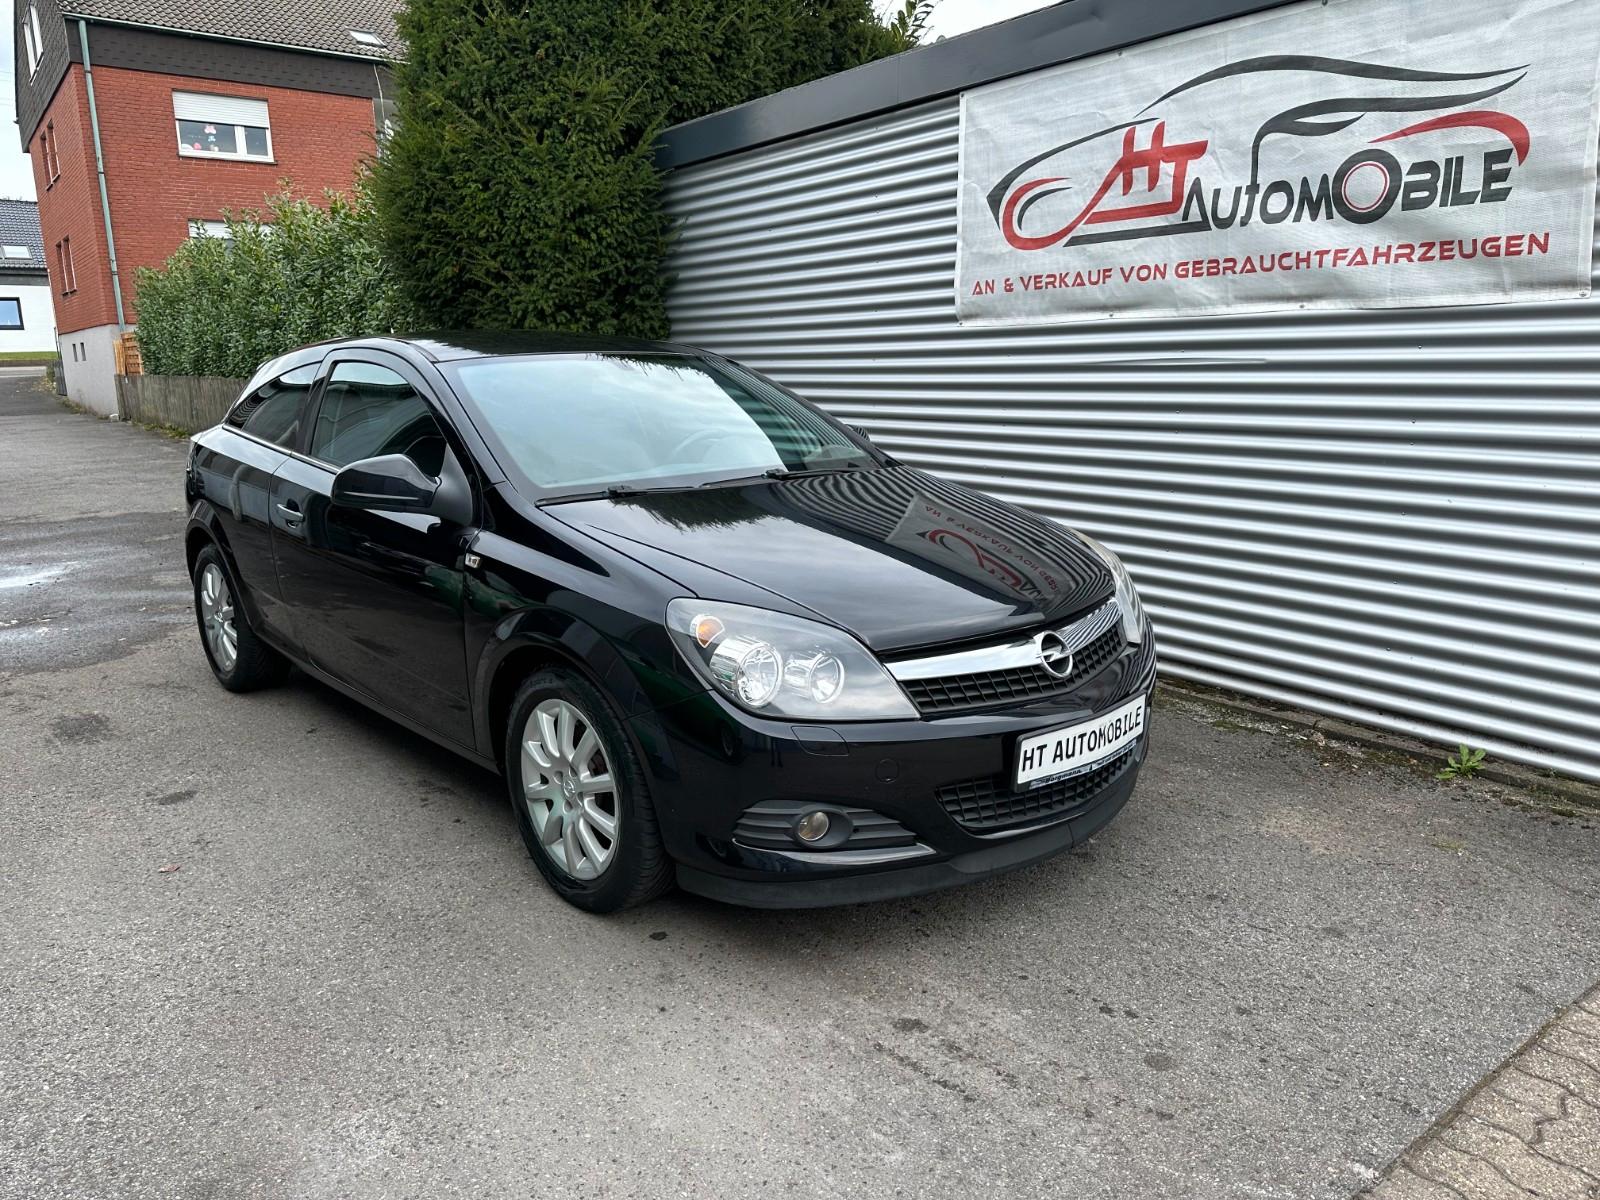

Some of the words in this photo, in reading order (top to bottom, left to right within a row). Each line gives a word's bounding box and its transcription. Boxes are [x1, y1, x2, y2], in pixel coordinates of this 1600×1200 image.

[1120, 121, 1208, 214] HT
[1182, 148, 1513, 231] AUTOMOBILE
[972, 279, 996, 296] AN
[1003, 277, 1014, 293] &
[1019, 267, 1113, 292] VERKAUF
[1120, 262, 1167, 282] VON
[1174, 232, 1550, 280] GEBRAUCHTFAHRZEUGEN
[1022, 744, 1048, 772] HT
[1052, 706, 1142, 763] AUTOMOBILE
